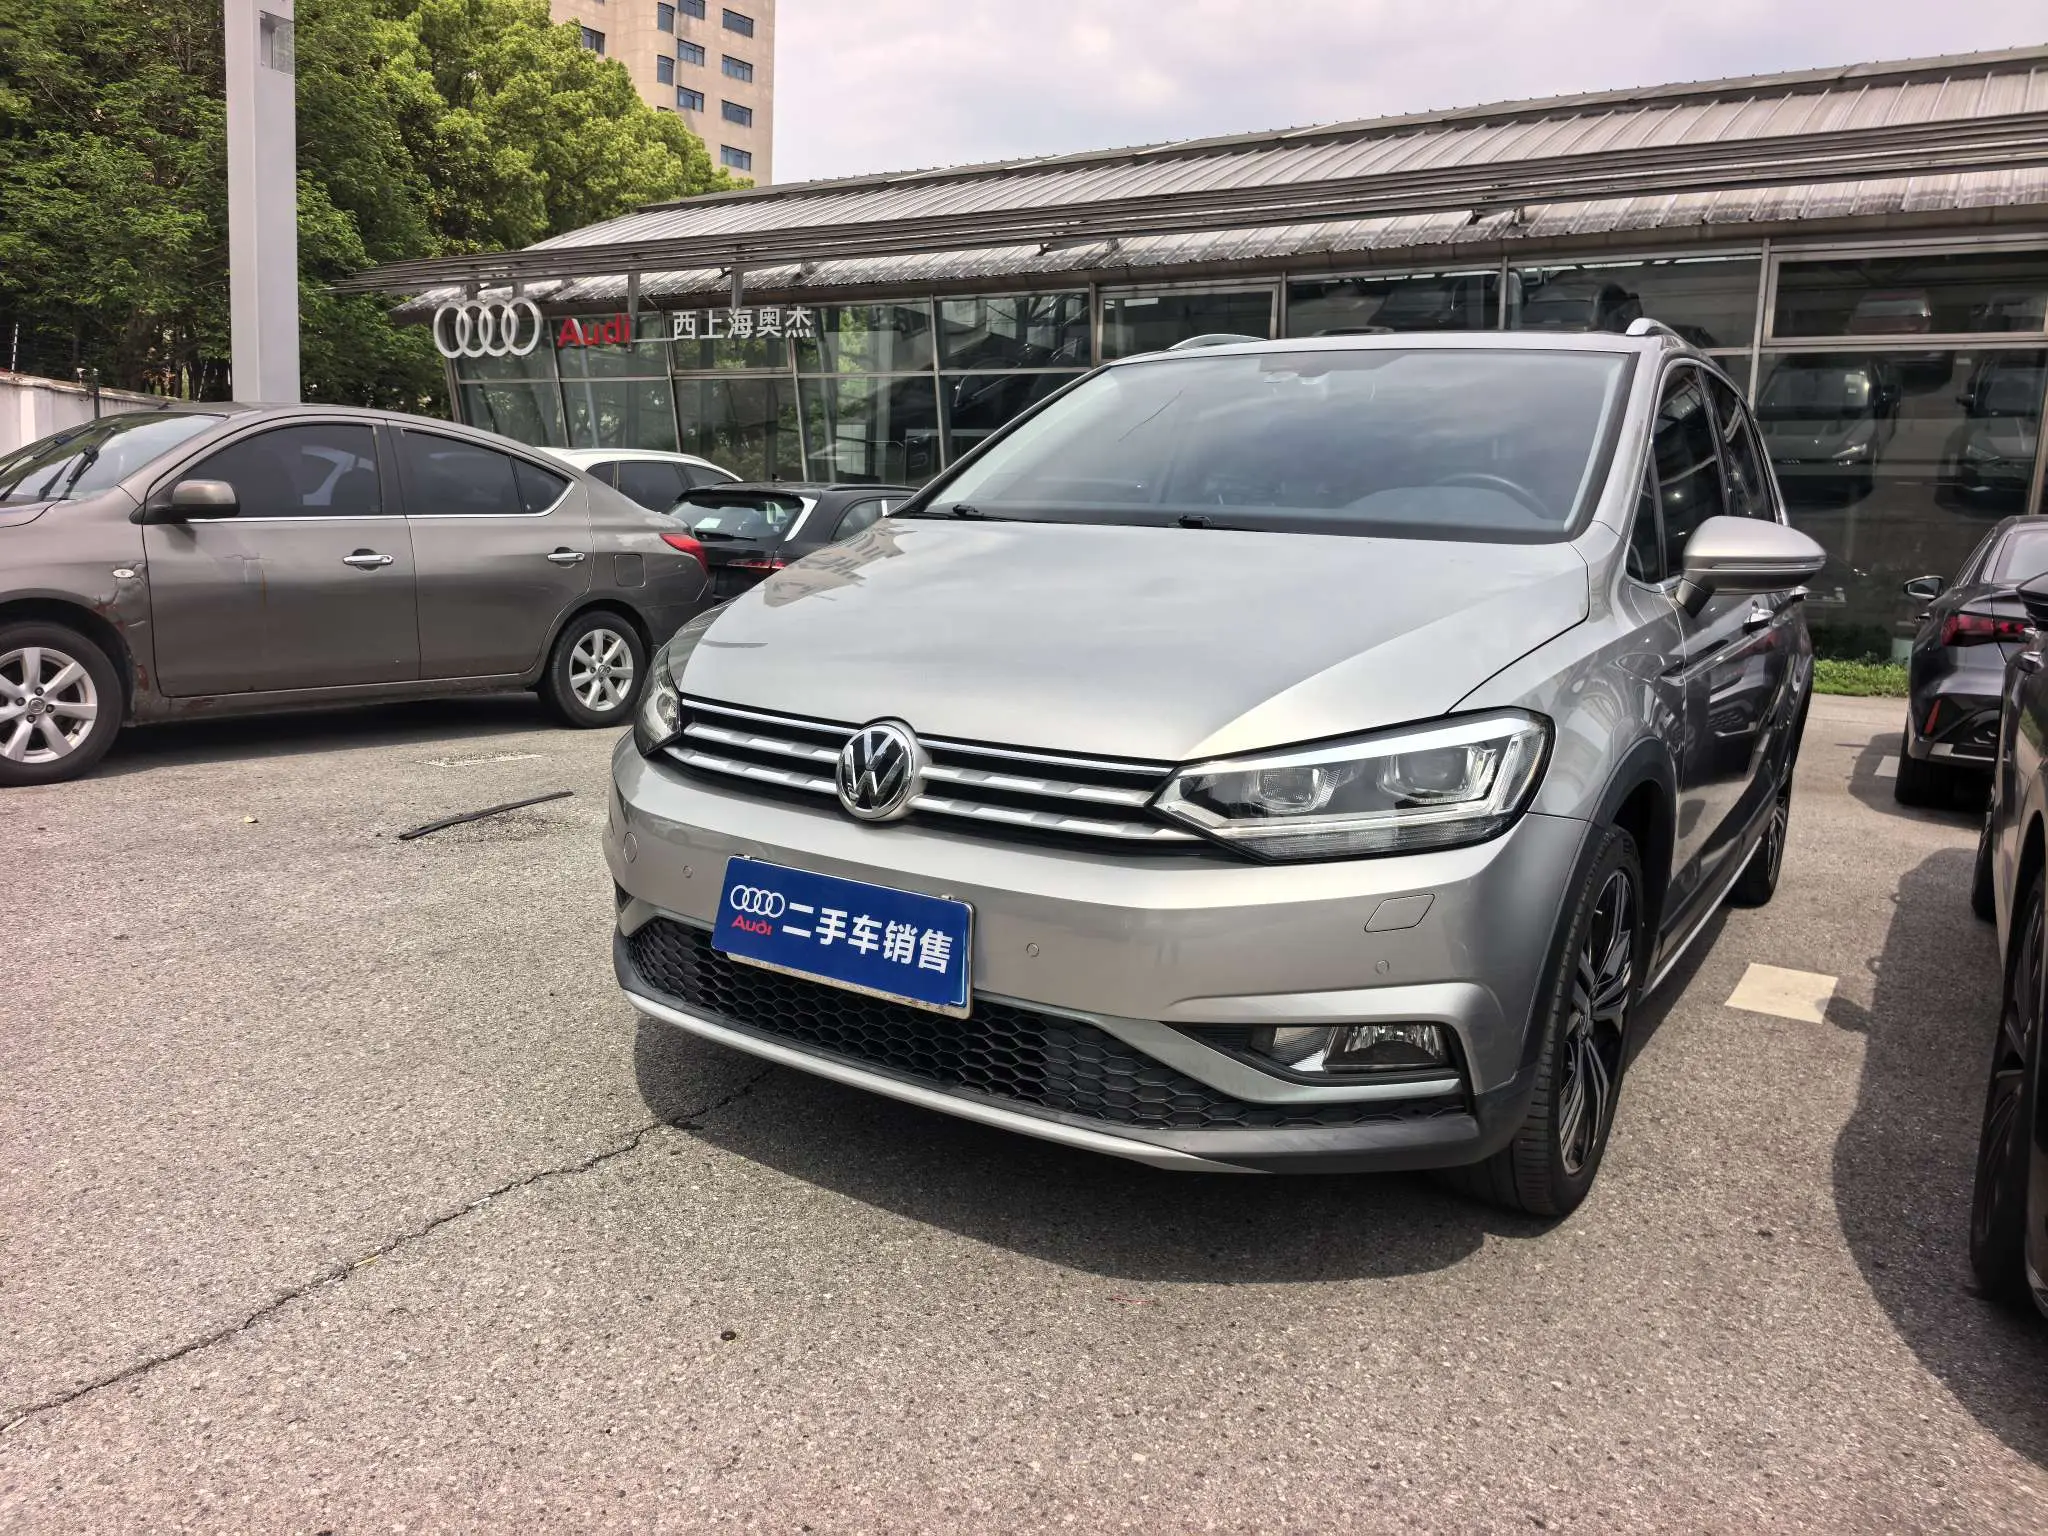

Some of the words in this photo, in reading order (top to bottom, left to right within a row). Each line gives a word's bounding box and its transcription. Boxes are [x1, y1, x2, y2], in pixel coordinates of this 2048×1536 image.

[558, 314, 631, 347] Audi
[672, 306, 812, 340] 西上海奥杰
[731, 915, 773, 936] Audi
[782, 902, 953, 974] 二手车销售
